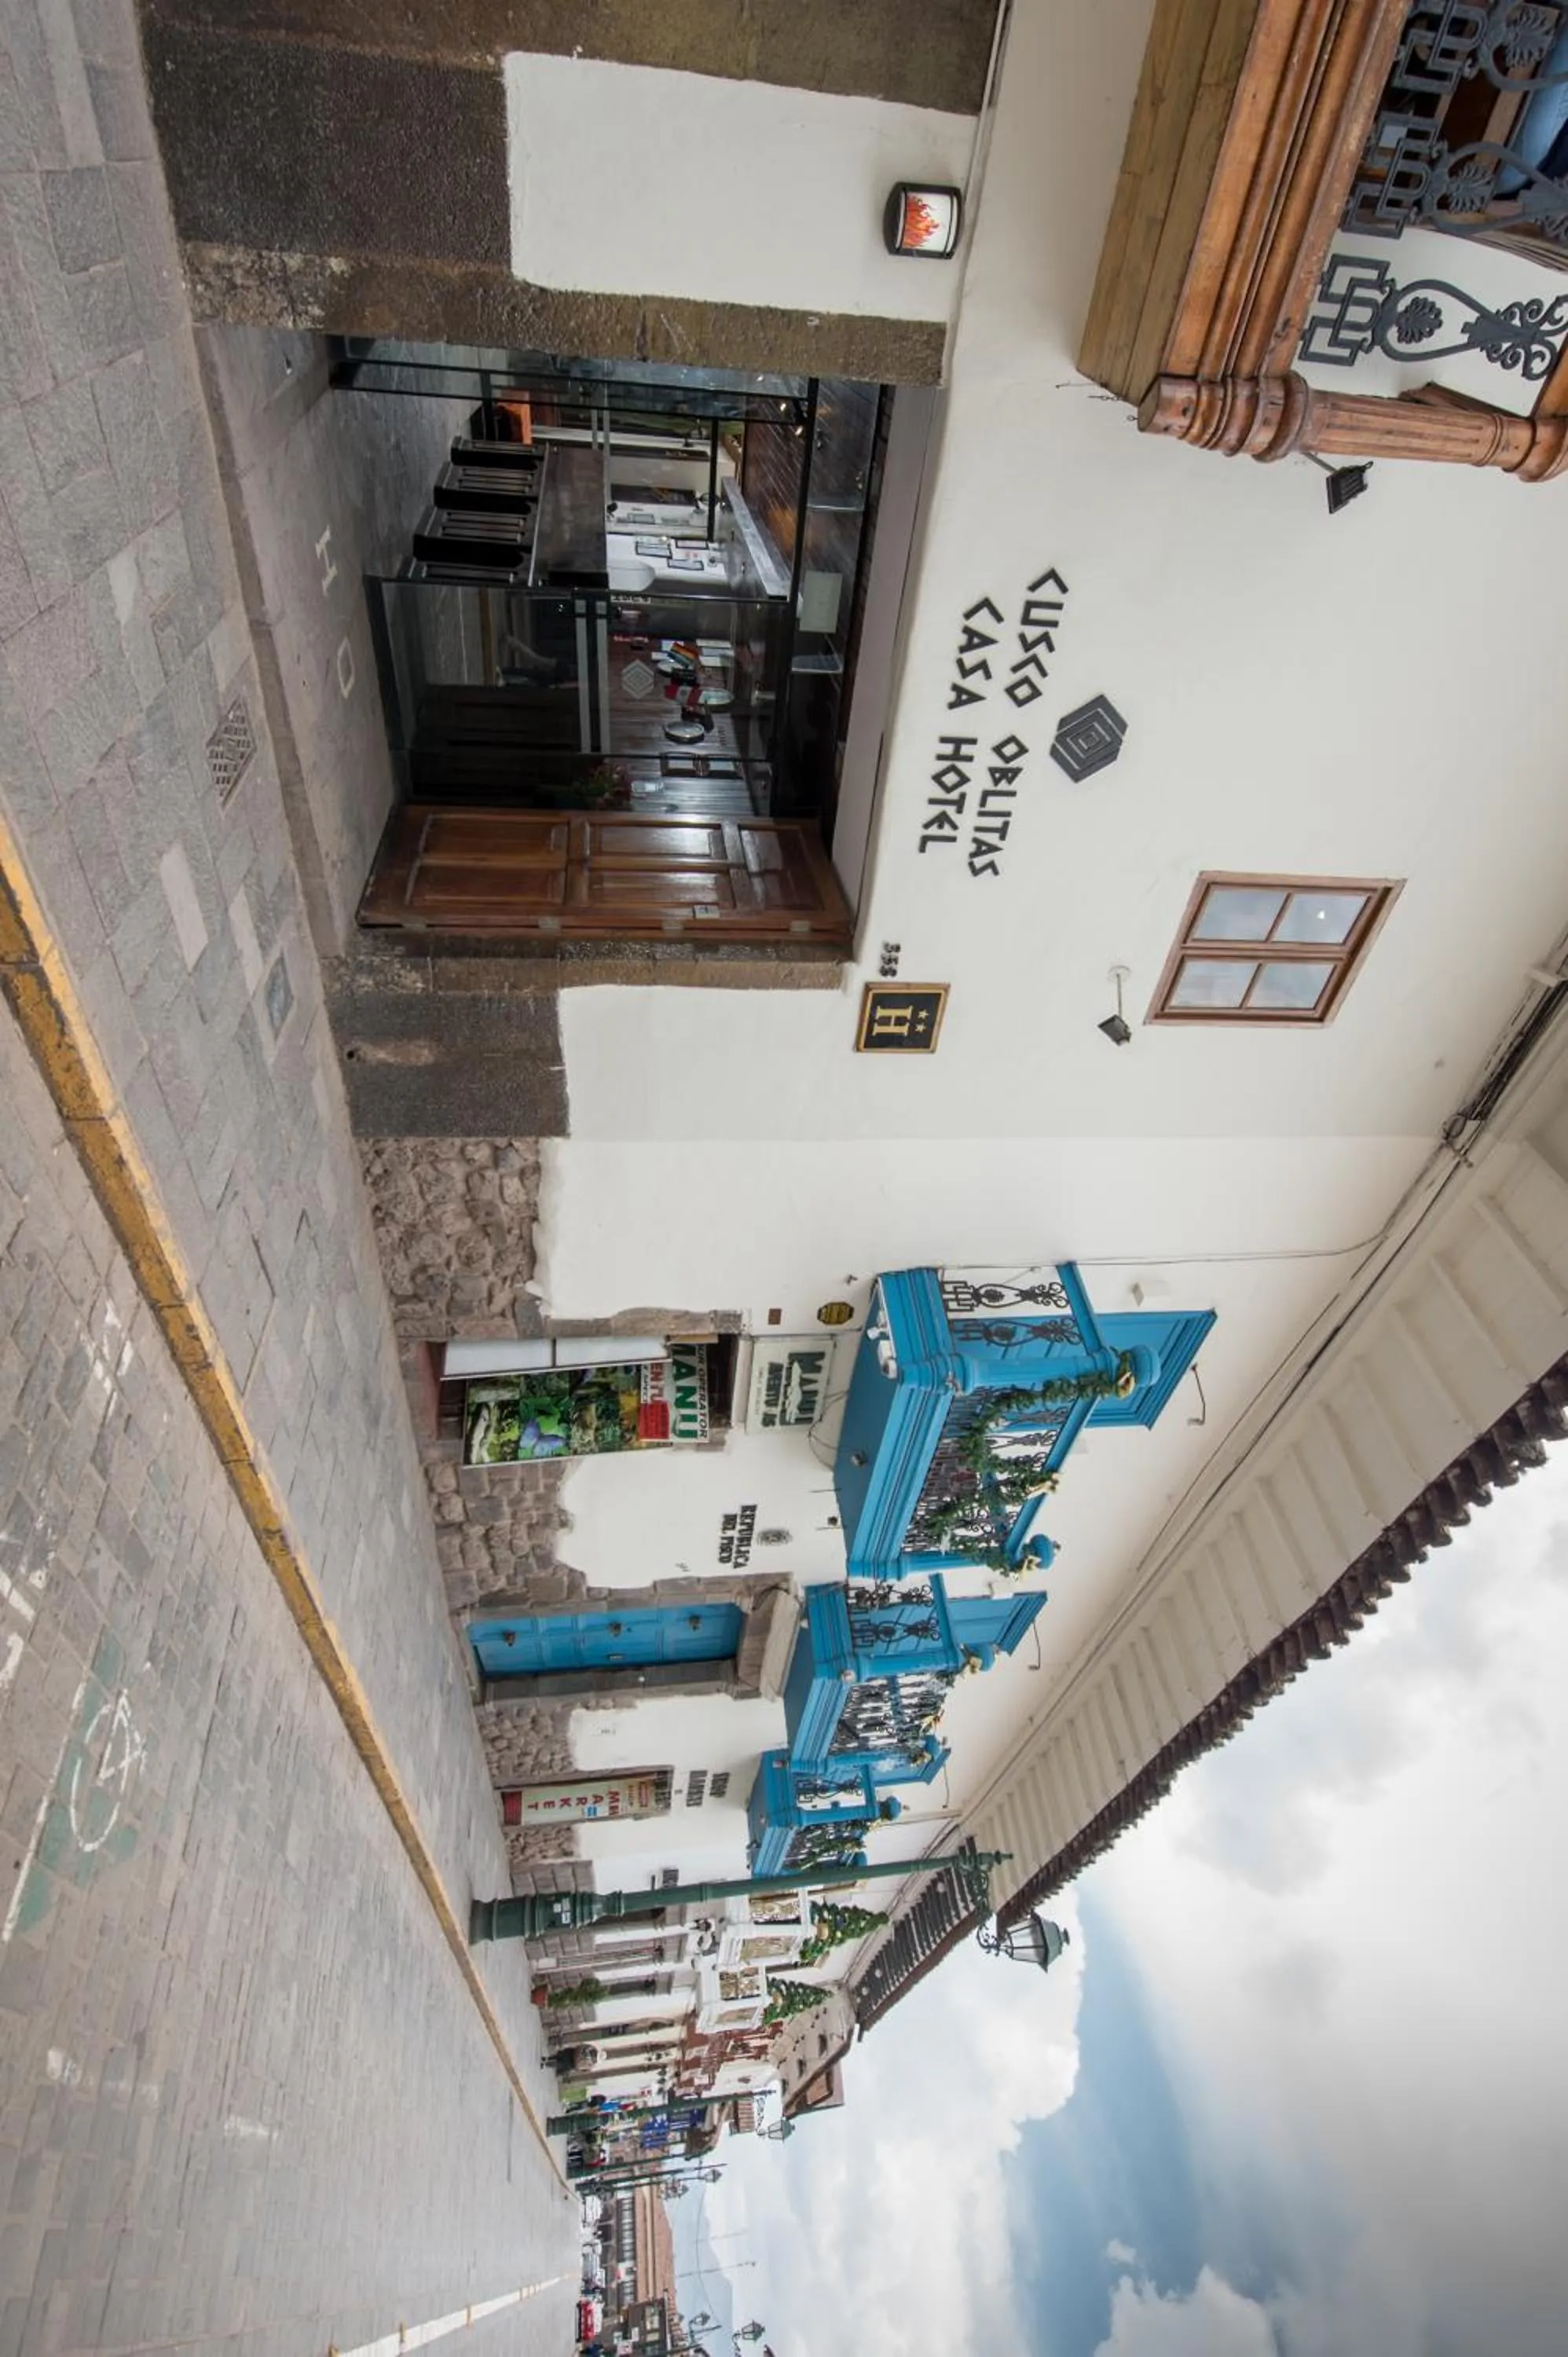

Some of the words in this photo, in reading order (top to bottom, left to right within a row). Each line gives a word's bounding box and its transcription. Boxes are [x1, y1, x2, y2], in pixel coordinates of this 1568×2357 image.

[947, 596, 1006, 710] CASA
[1004, 567, 1069, 709] CUSCO
[918, 735, 978, 854] HOTEL
[967, 735, 1030, 878] OBLITAS
[872, 1005, 914, 1037] H
[698, 1368, 708, 1438] OPERATOR
[719, 1536, 735, 1564] PISCO
[722, 1513, 738, 1534] DEL
[733, 1505, 758, 1569] REPUBLICA
